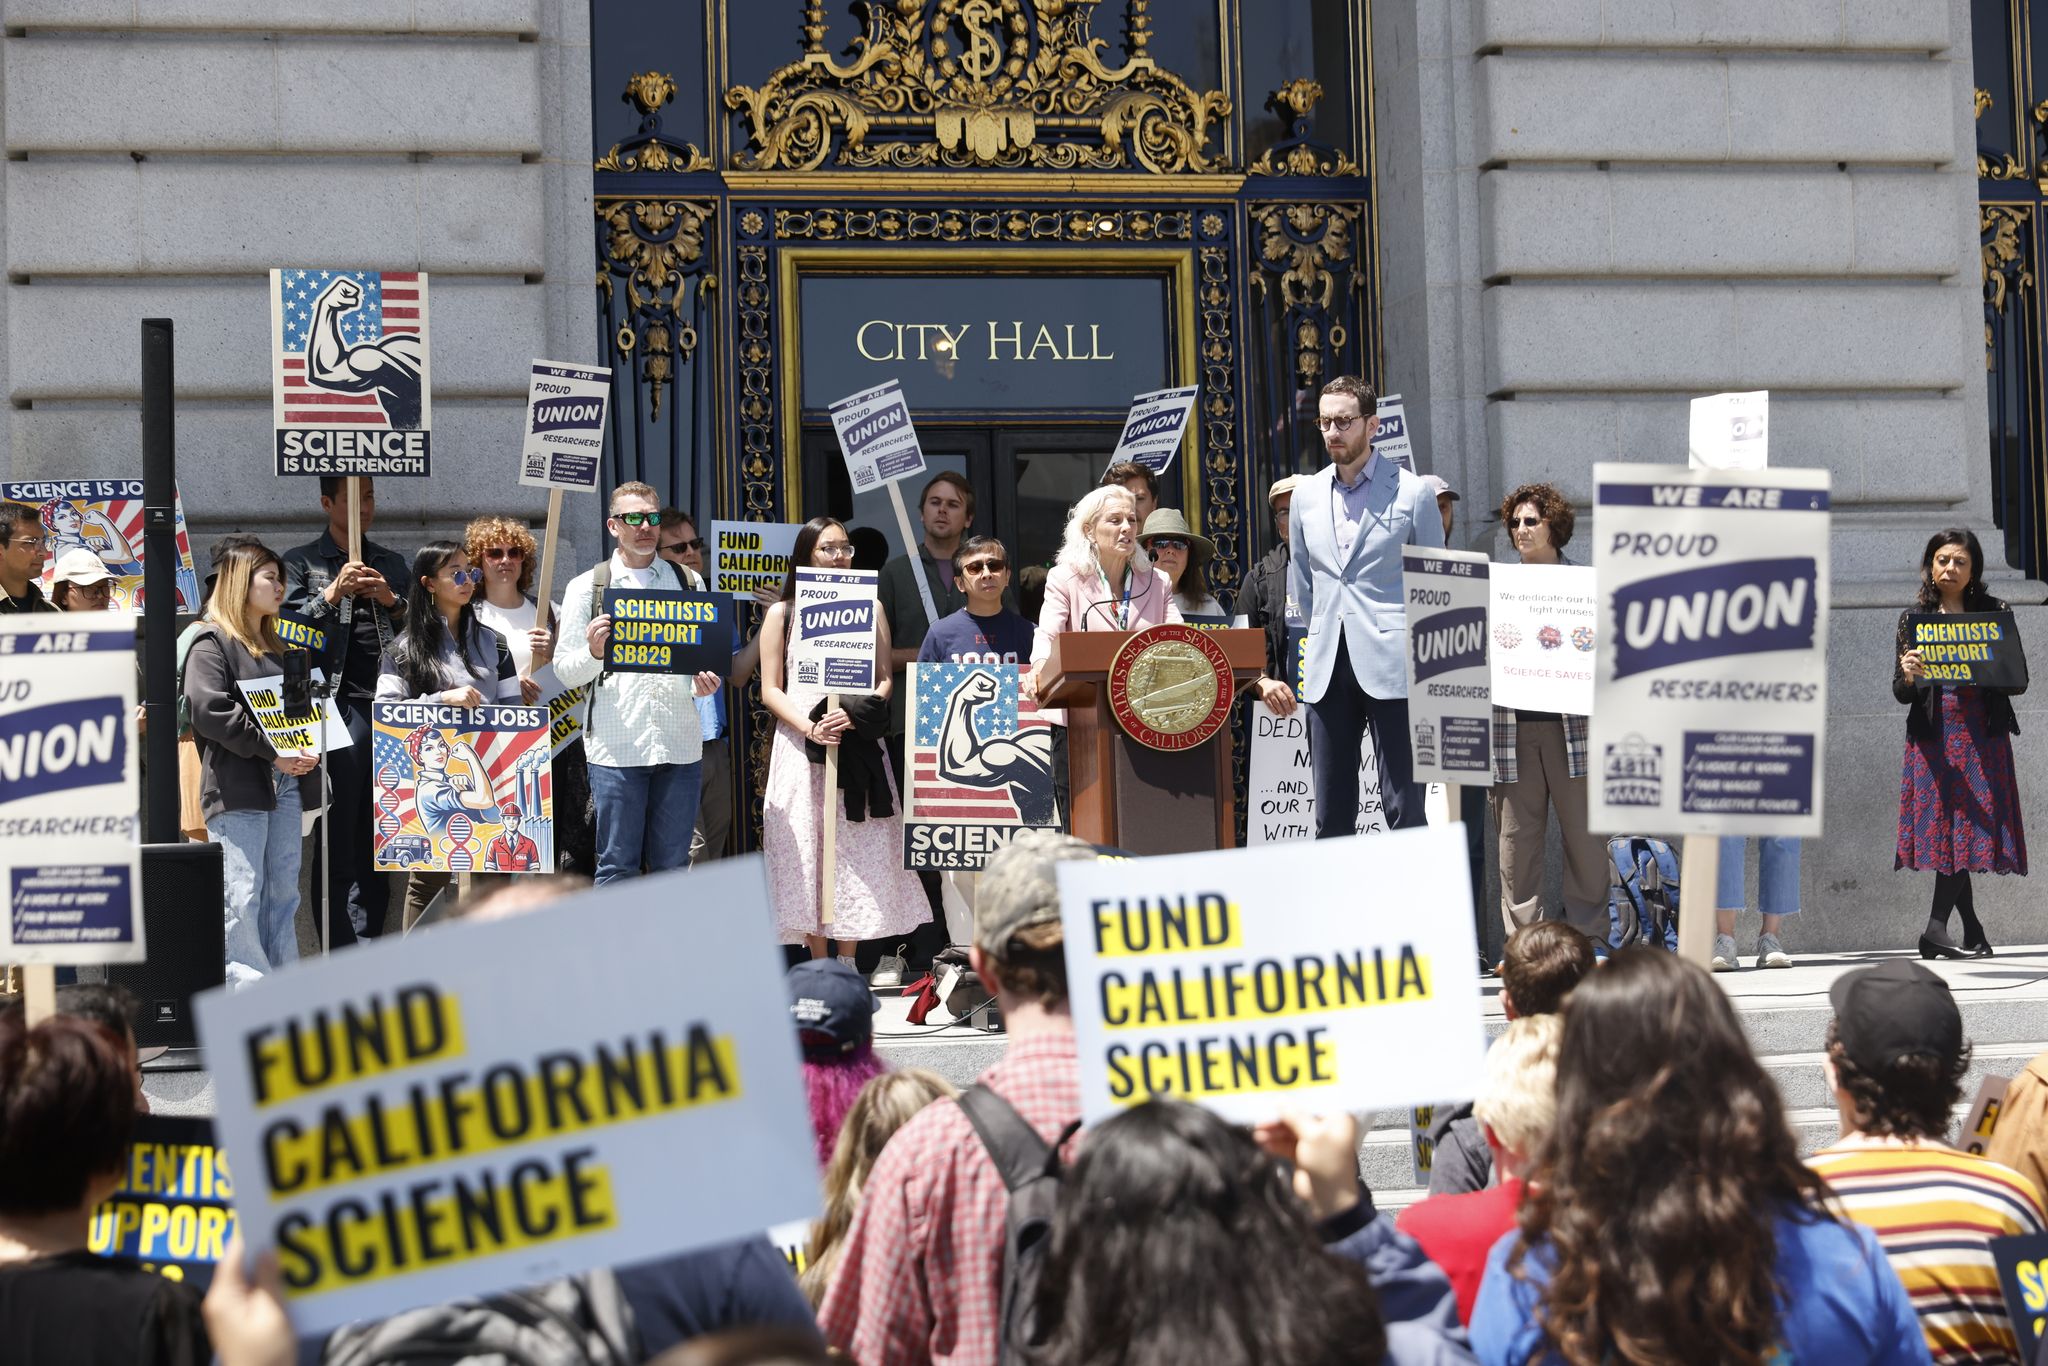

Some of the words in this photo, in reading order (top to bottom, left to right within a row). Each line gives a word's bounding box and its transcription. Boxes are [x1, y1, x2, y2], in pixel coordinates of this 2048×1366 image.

[856, 320, 971, 361] CITY
[987, 321, 1115, 360] HALL
[550, 368, 567, 377] WE
[573, 371, 595, 380] ARE
[535, 382, 571, 395] PROUD
[846, 398, 861, 408] WE
[867, 389, 886, 401] ARE
[1146, 395, 1160, 403] WE
[537, 404, 600, 424] UNION
[837, 407, 871, 425] PROUD
[1131, 405, 1160, 418] PROUD
[849, 408, 902, 446] UNION
[1127, 412, 1182, 438] UNION
[283, 431, 425, 457] SCIENCE
[542, 434, 601, 448] RESEARCHERS
[861, 432, 914, 456] RESEARCHERS
[1128, 438, 1177, 449] RESEARCHERS
[284, 457, 300, 472] IS
[303, 457, 334, 473] U.S.
[335, 457, 425, 473] STRENGTH
[10, 482, 91, 499] SCIENCE
[97, 482, 115, 496] IS
[1652, 487, 1702, 506] WE
[1721, 488, 1782, 509] ARE
[718, 531, 760, 550] FUND
[1611, 532, 1719, 557] PROUD
[1423, 559, 1443, 573] WE
[1450, 563, 1472, 576] ARE
[815, 574, 833, 582] WE
[839, 575, 861, 584] ARE
[800, 589, 838, 600] PROUD
[1410, 588, 1451, 607] PROUD
[1499, 592, 1515, 601] We
[1519, 593, 1563, 602] dedicate
[1566, 595, 1583, 603] our
[614, 598, 715, 621] SCIENTISTS
[805, 607, 869, 630] UNION
[1529, 605, 1553, 615] fight
[1556, 608, 1594, 617] viruses
[1624, 577, 1808, 650] UNION
[614, 621, 699, 644] SUPPORT
[1417, 620, 1483, 664] UNION
[1916, 622, 2000, 642] SCIENTISTS
[34, 632, 89, 653] ARE
[813, 640, 874, 650] RESEARCHERS
[613, 643, 671, 665] SB829
[1122, 632, 1159, 664] SEAL
[1182, 629, 1230, 678] SENATE
[800, 665, 818, 673] 4811
[1503, 665, 1551, 678] SCIENCE
[1555, 670, 1592, 681] SAVES
[1922, 663, 1972, 680] SB829
[246, 688, 277, 709] FUND
[1427, 683, 1489, 700] RESEARCHERS
[1649, 679, 1818, 702] RESEARCHERS
[381, 705, 463, 725] SCIENCE
[468, 706, 486, 725] IS
[490, 708, 541, 727] JOBS
[1113, 668, 1134, 722] STATE
[1140, 707, 1227, 748] CALIFORNIA
[268, 728, 313, 750] SCIENCE
[1261, 799, 1299, 815] OUR
[910, 825, 1057, 852] SCIEN
[1264, 823, 1308, 841] WITH
[910, 852, 927, 866] IS
[931, 852, 962, 867] U.S.
[1090, 892, 1231, 955] FUND
[1097, 942, 1428, 1026] CALIFORNIA
[245, 980, 452, 1103] FUND
[1104, 1027, 1332, 1099] SCIENCE
[261, 1019, 734, 1197] CALIFORNIA
[275, 1146, 610, 1291] SCIENCE
